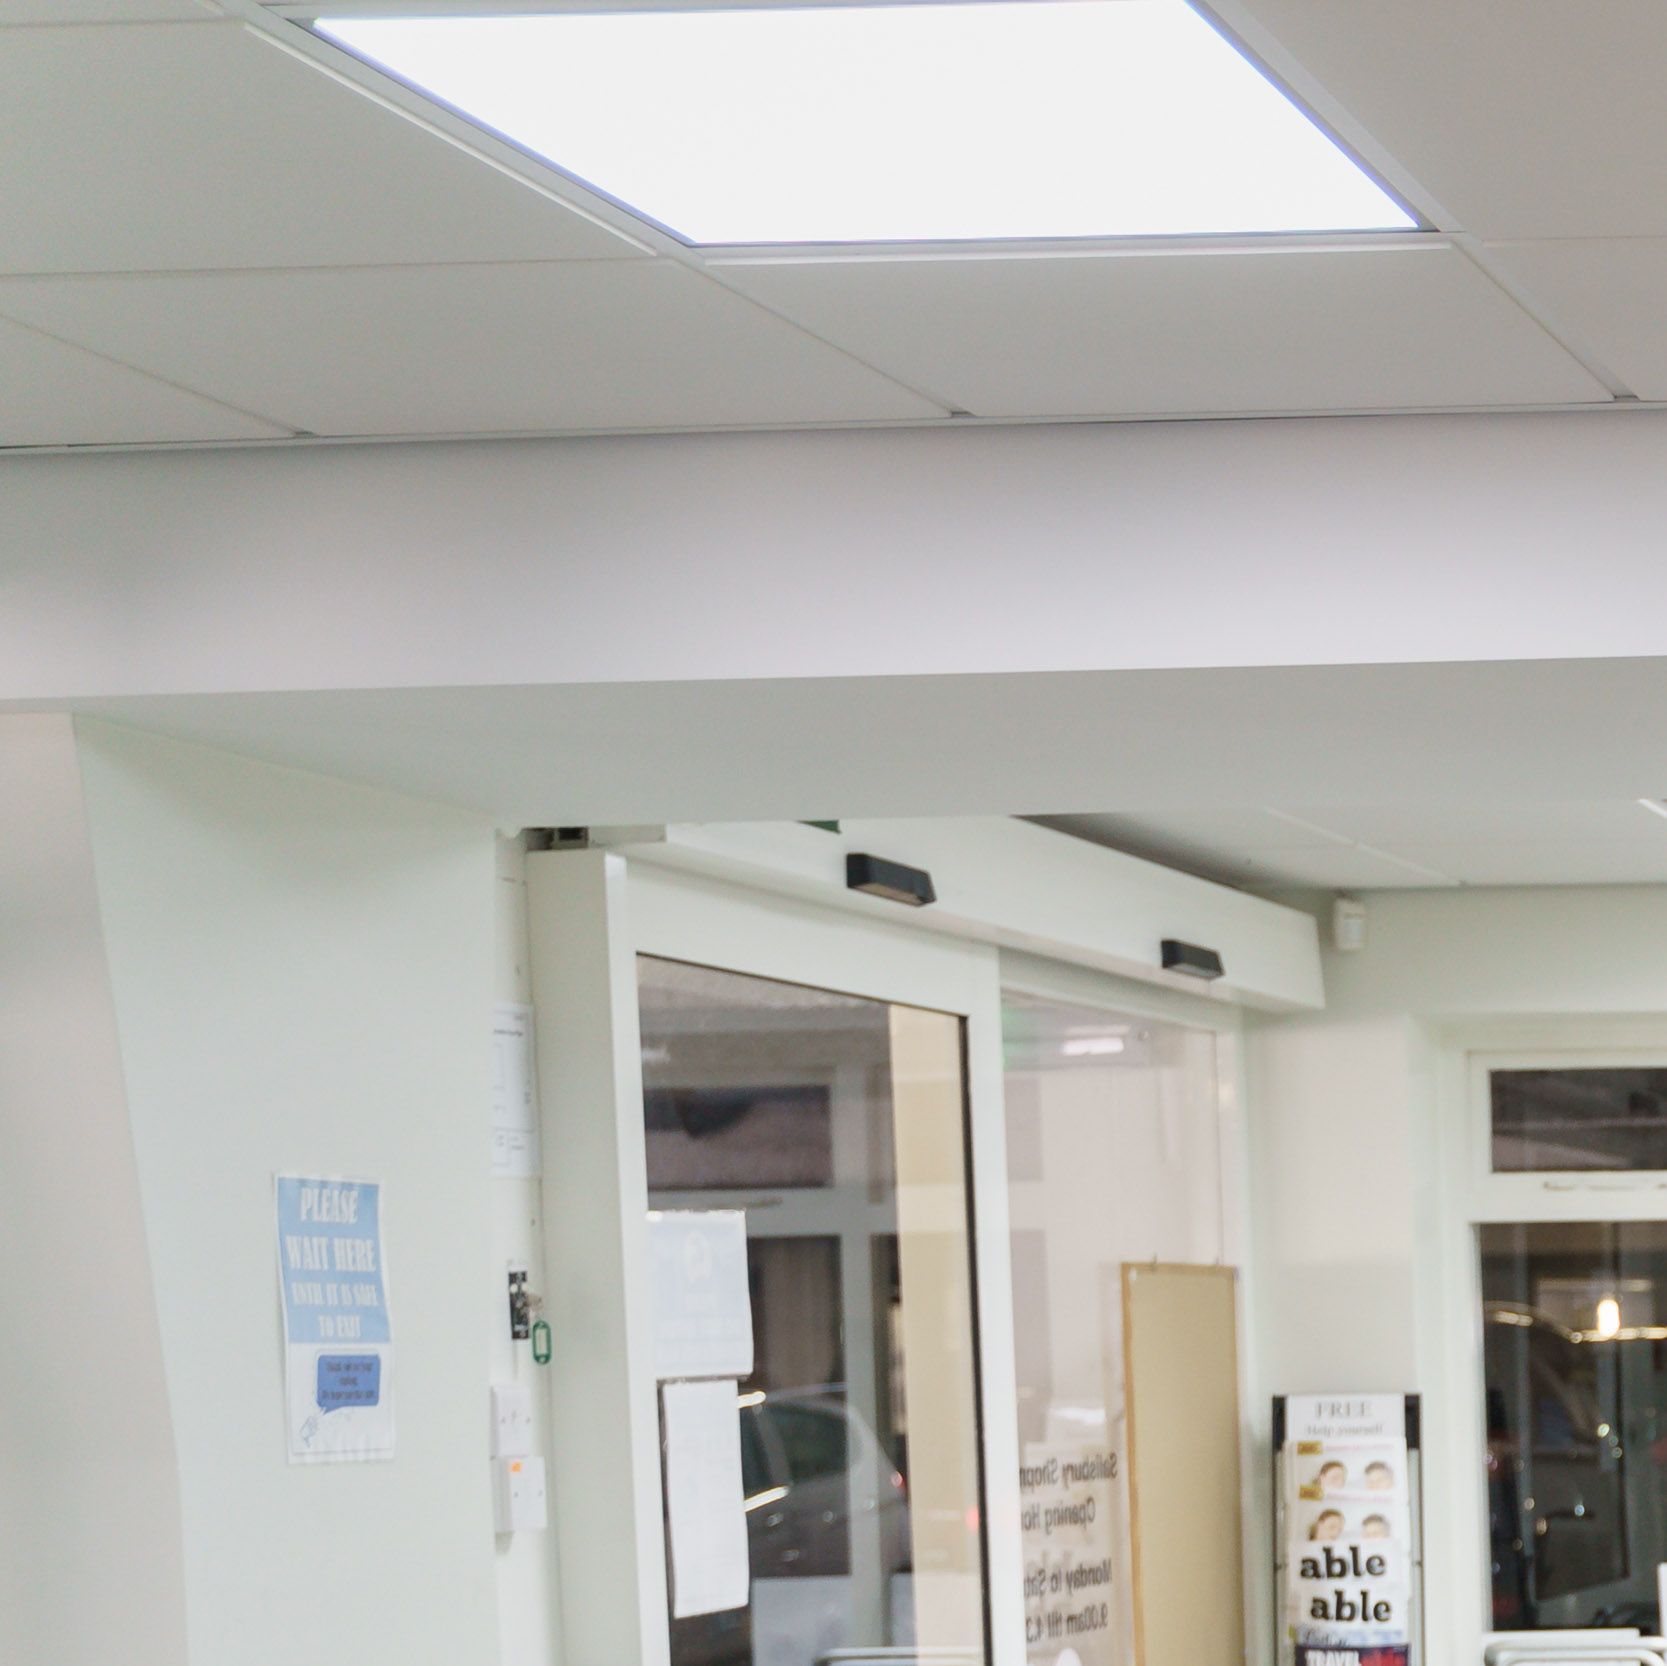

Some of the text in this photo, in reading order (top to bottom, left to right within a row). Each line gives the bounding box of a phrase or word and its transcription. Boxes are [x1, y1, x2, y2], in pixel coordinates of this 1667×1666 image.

[301, 1187, 359, 1224] PLEASE
[285, 1235, 377, 1272] WAIT HERE
[317, 1315, 362, 1338] TO EXIT
[1315, 1402, 1372, 1418] FREE
[1300, 1546, 1386, 1579] able
[1310, 1590, 1392, 1622] able
